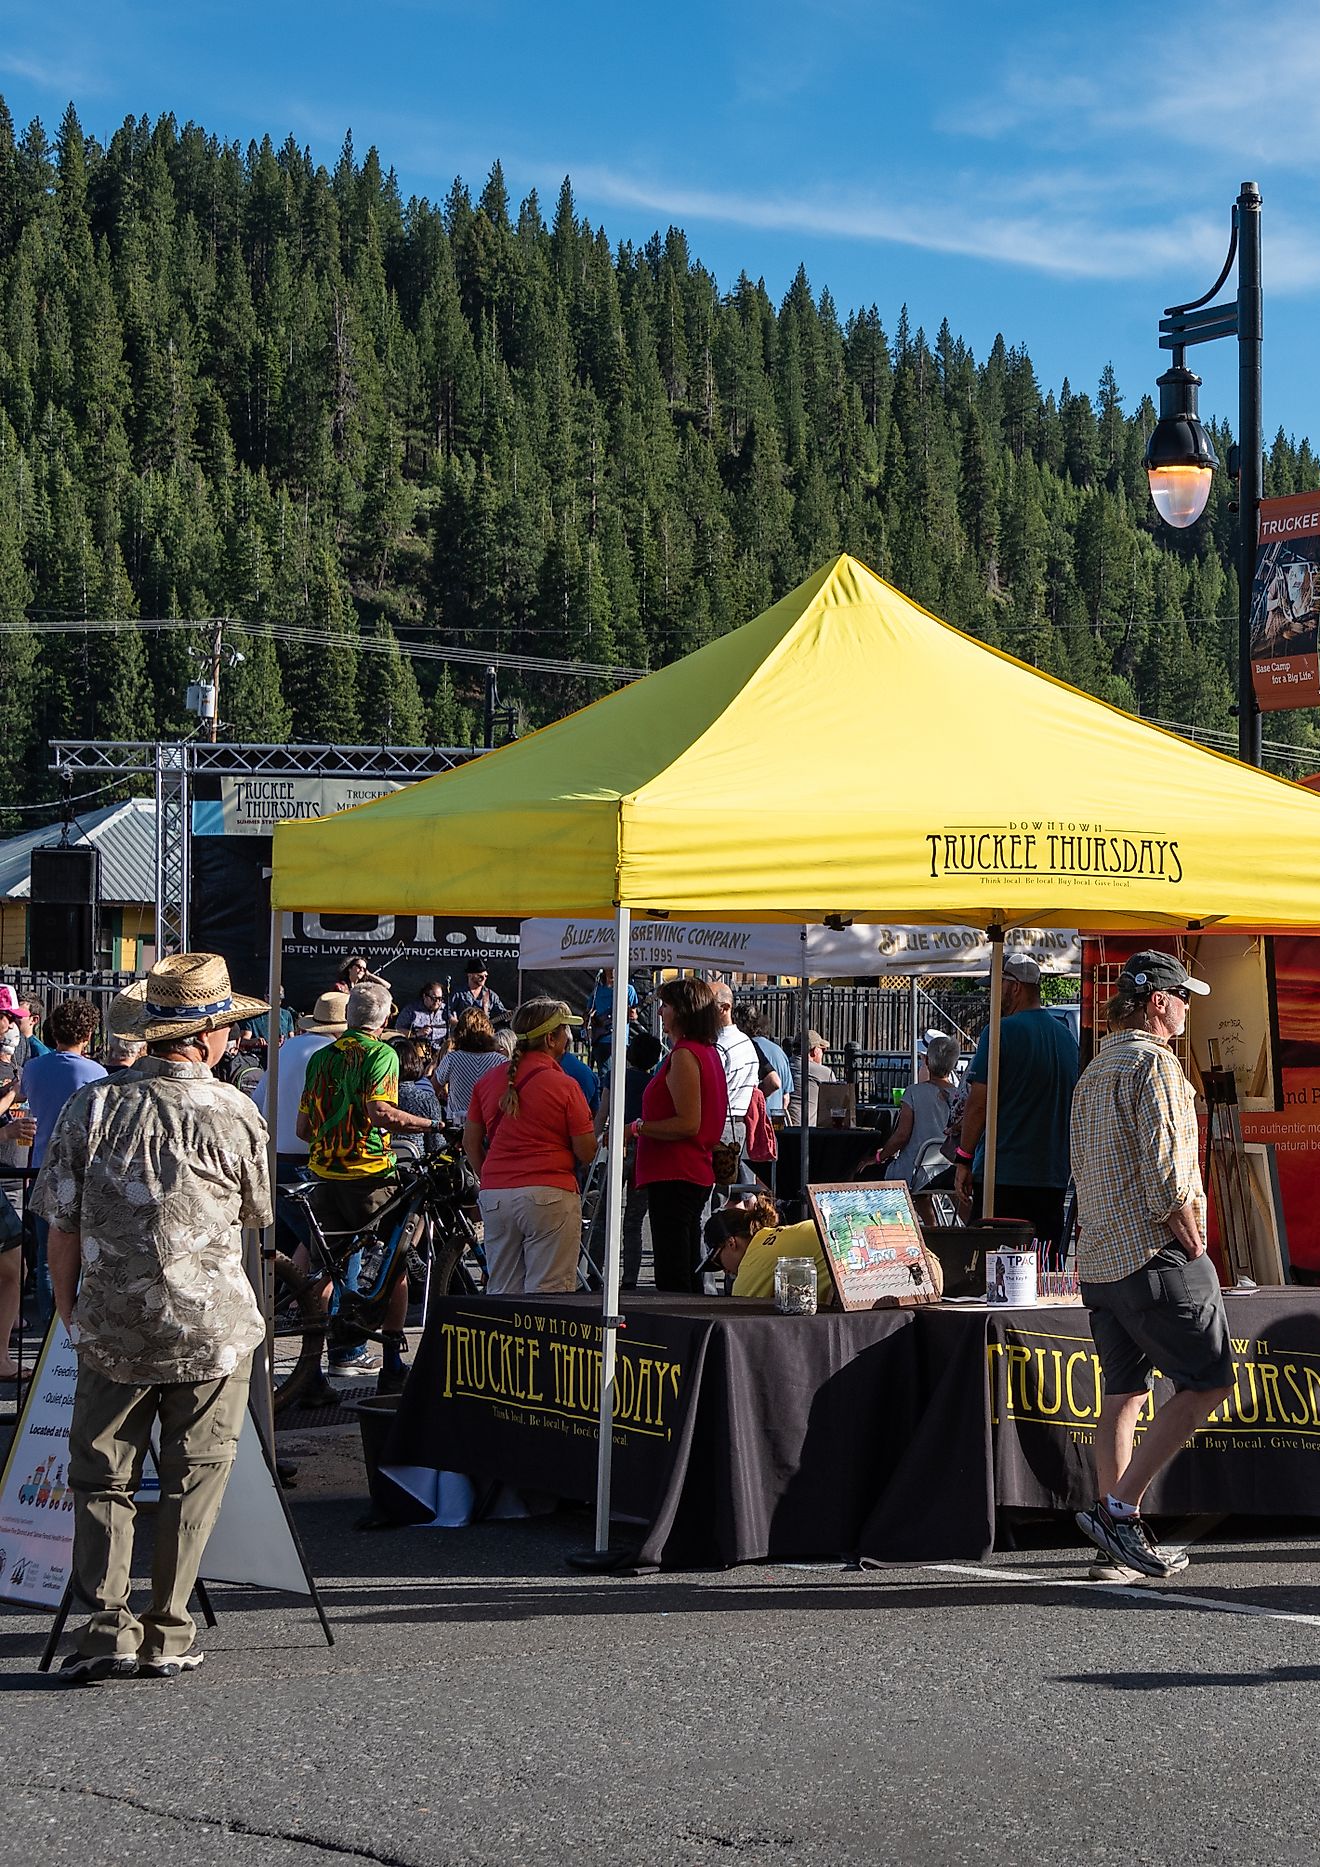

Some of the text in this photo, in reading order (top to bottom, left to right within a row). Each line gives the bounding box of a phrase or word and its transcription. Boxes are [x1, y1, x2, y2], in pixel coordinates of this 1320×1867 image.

[1261, 512, 1319, 536] TRUCKEE
[1256, 662, 1290, 674] Base Camp
[1272, 675, 1281, 684] for
[1287, 674, 1298, 683] Big
[234, 782, 295, 812] TRUCKEE
[246, 801, 321, 819] THURSDAYS
[1009, 821, 1103, 833] DOWNTOWN
[926, 834, 1183, 883] TRUCKEE THURSDAYS
[561, 924, 595, 950] BLUE
[878, 929, 930, 957] BLUE
[281, 944, 320, 954] ISTEN
[321, 944, 348, 955] LIVE
[350, 946, 365, 955] AT
[650, 948, 673, 964] 1995
[1244, 1125, 1258, 1134] an
[1260, 1122, 1306, 1134] authentic
[1274, 1138, 1309, 1151] natural
[1006, 1256, 1034, 1266] TPAC
[441, 1323, 543, 1401] TRUCKEE
[53, 1366, 79, 1380] Feeding
[45, 1392, 62, 1404] Quiet
[29, 1424, 54, 1436] Located
[54, 1428, 62, 1436] at
[612, 1436, 629, 1446] ocal.
[1205, 1438, 1228, 1454] Buy
[1232, 1438, 1267, 1450] local.
[1271, 1438, 1298, 1450] Give
